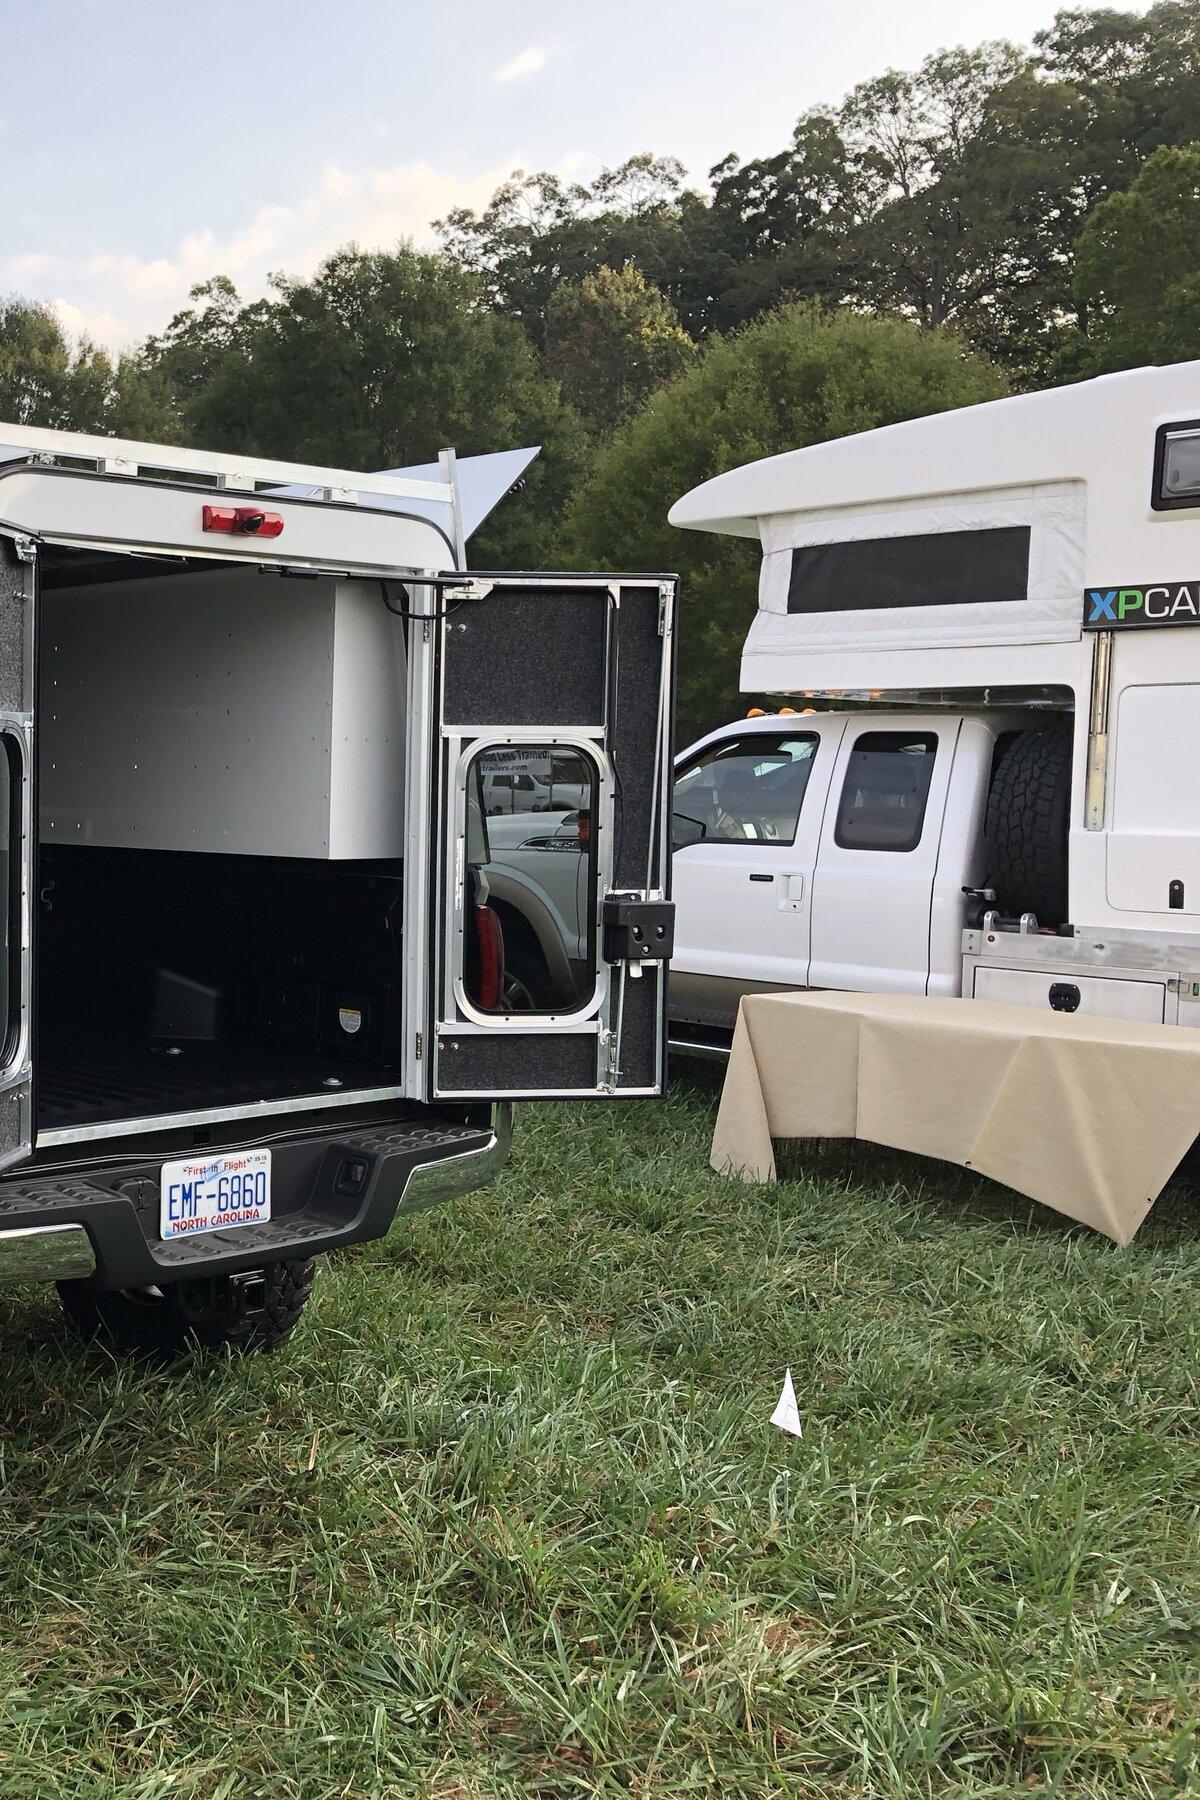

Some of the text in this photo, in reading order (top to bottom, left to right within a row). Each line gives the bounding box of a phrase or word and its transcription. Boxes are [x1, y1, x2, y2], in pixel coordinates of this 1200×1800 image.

[1088, 586, 1200, 621] XPCA
[188, 1166, 207, 1176] First
[224, 1160, 247, 1172] Flight
[169, 1171, 266, 1221] EMF-6860
[173, 1208, 260, 1232] NORTH CAROLINA
